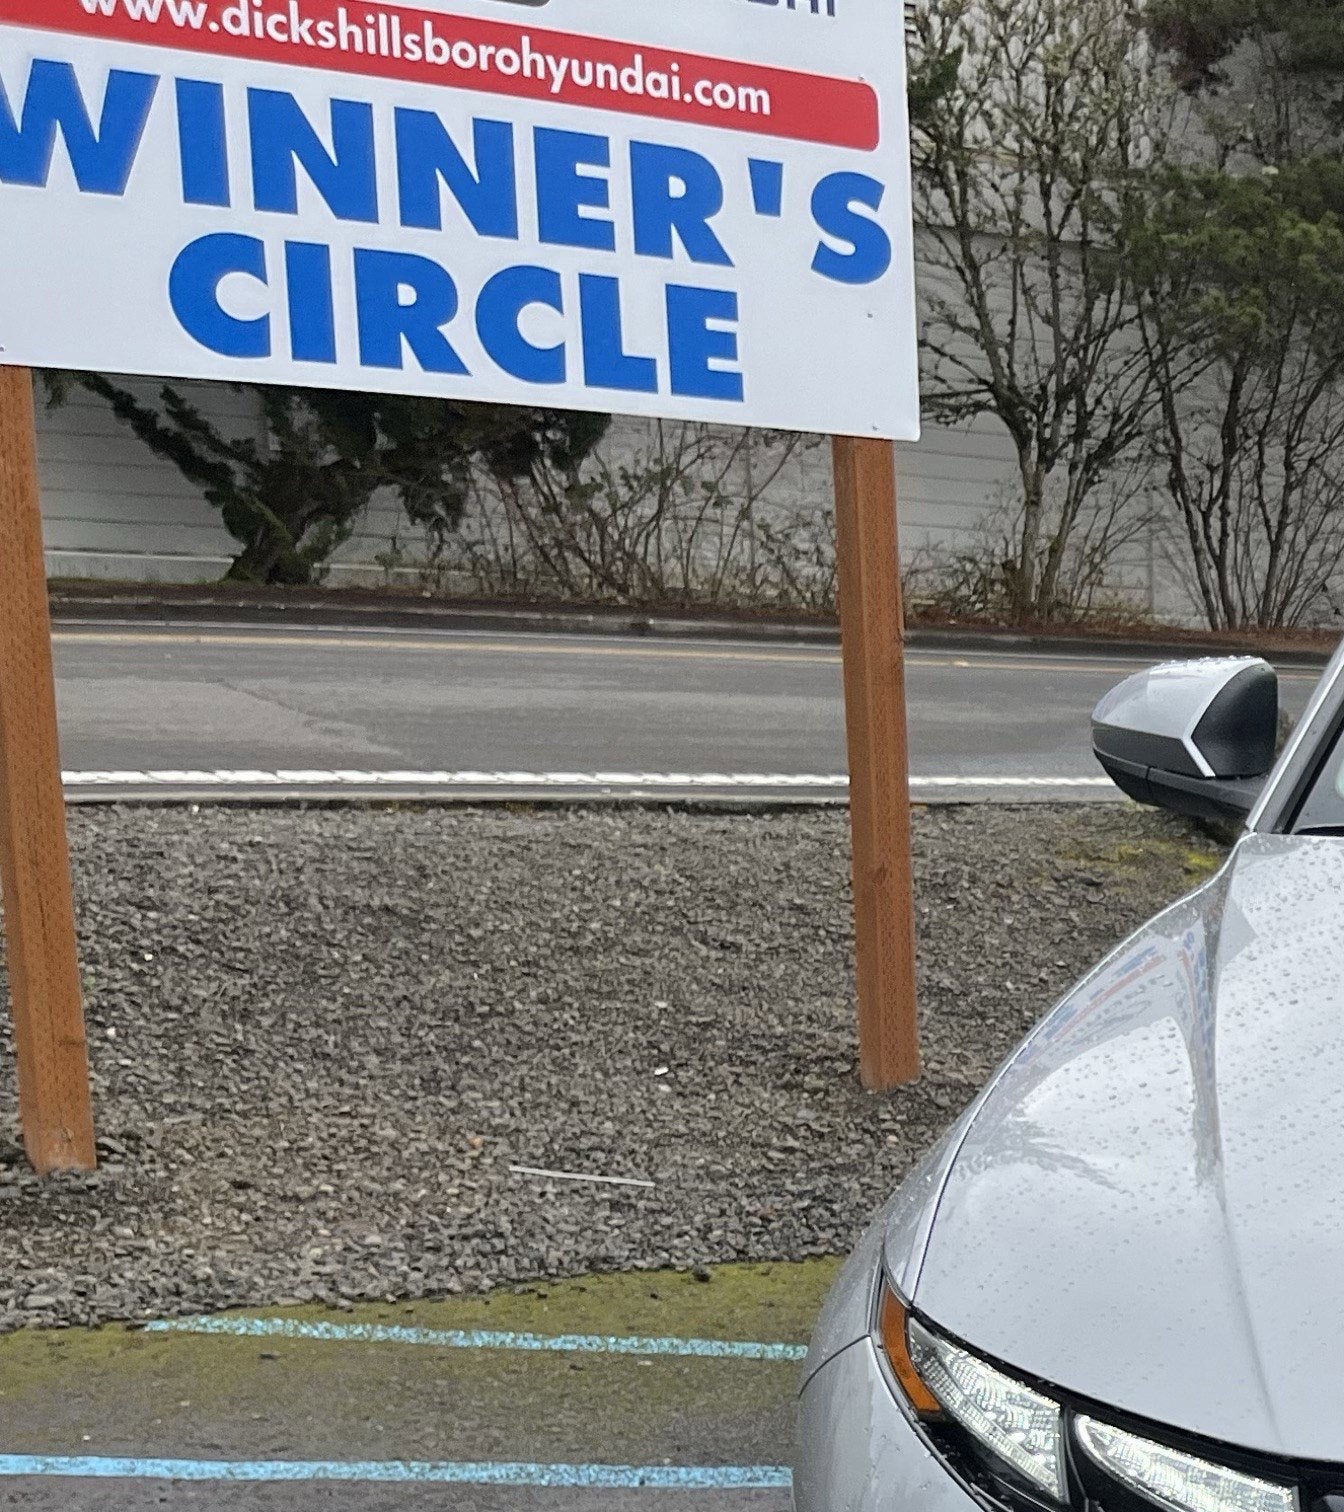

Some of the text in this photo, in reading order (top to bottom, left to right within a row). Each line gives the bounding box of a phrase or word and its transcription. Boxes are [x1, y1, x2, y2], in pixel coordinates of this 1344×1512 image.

[79, 0, 771, 115] www.dickshillsborohyundai.com
[0, 57, 892, 285] WINNER'S
[168, 231, 744, 402] CIRCLE
